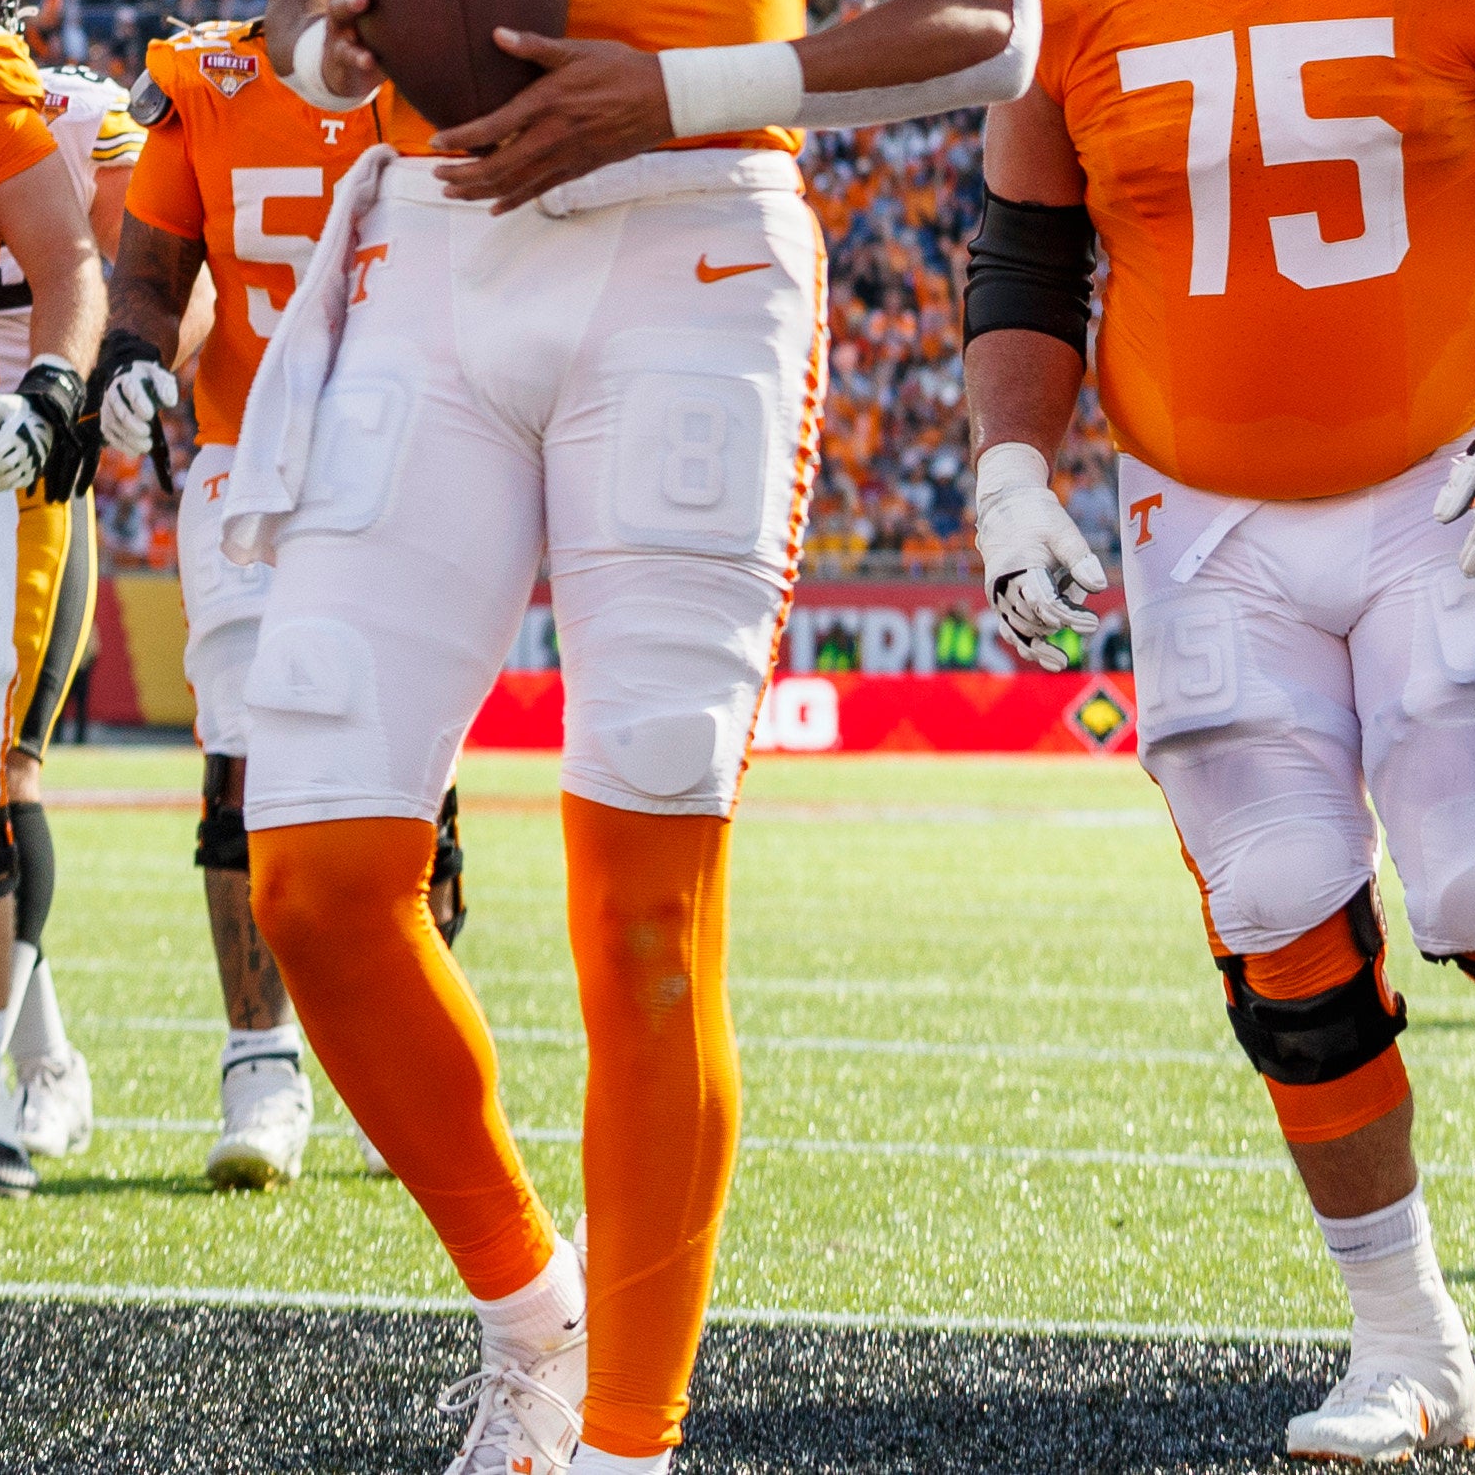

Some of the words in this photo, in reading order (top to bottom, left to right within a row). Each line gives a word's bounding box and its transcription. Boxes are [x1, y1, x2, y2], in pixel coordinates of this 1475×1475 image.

[320, 118, 346, 145] T
[1116, 16, 1411, 297] 75
[202, 470, 230, 504] T
[1129, 492, 1163, 548] T
